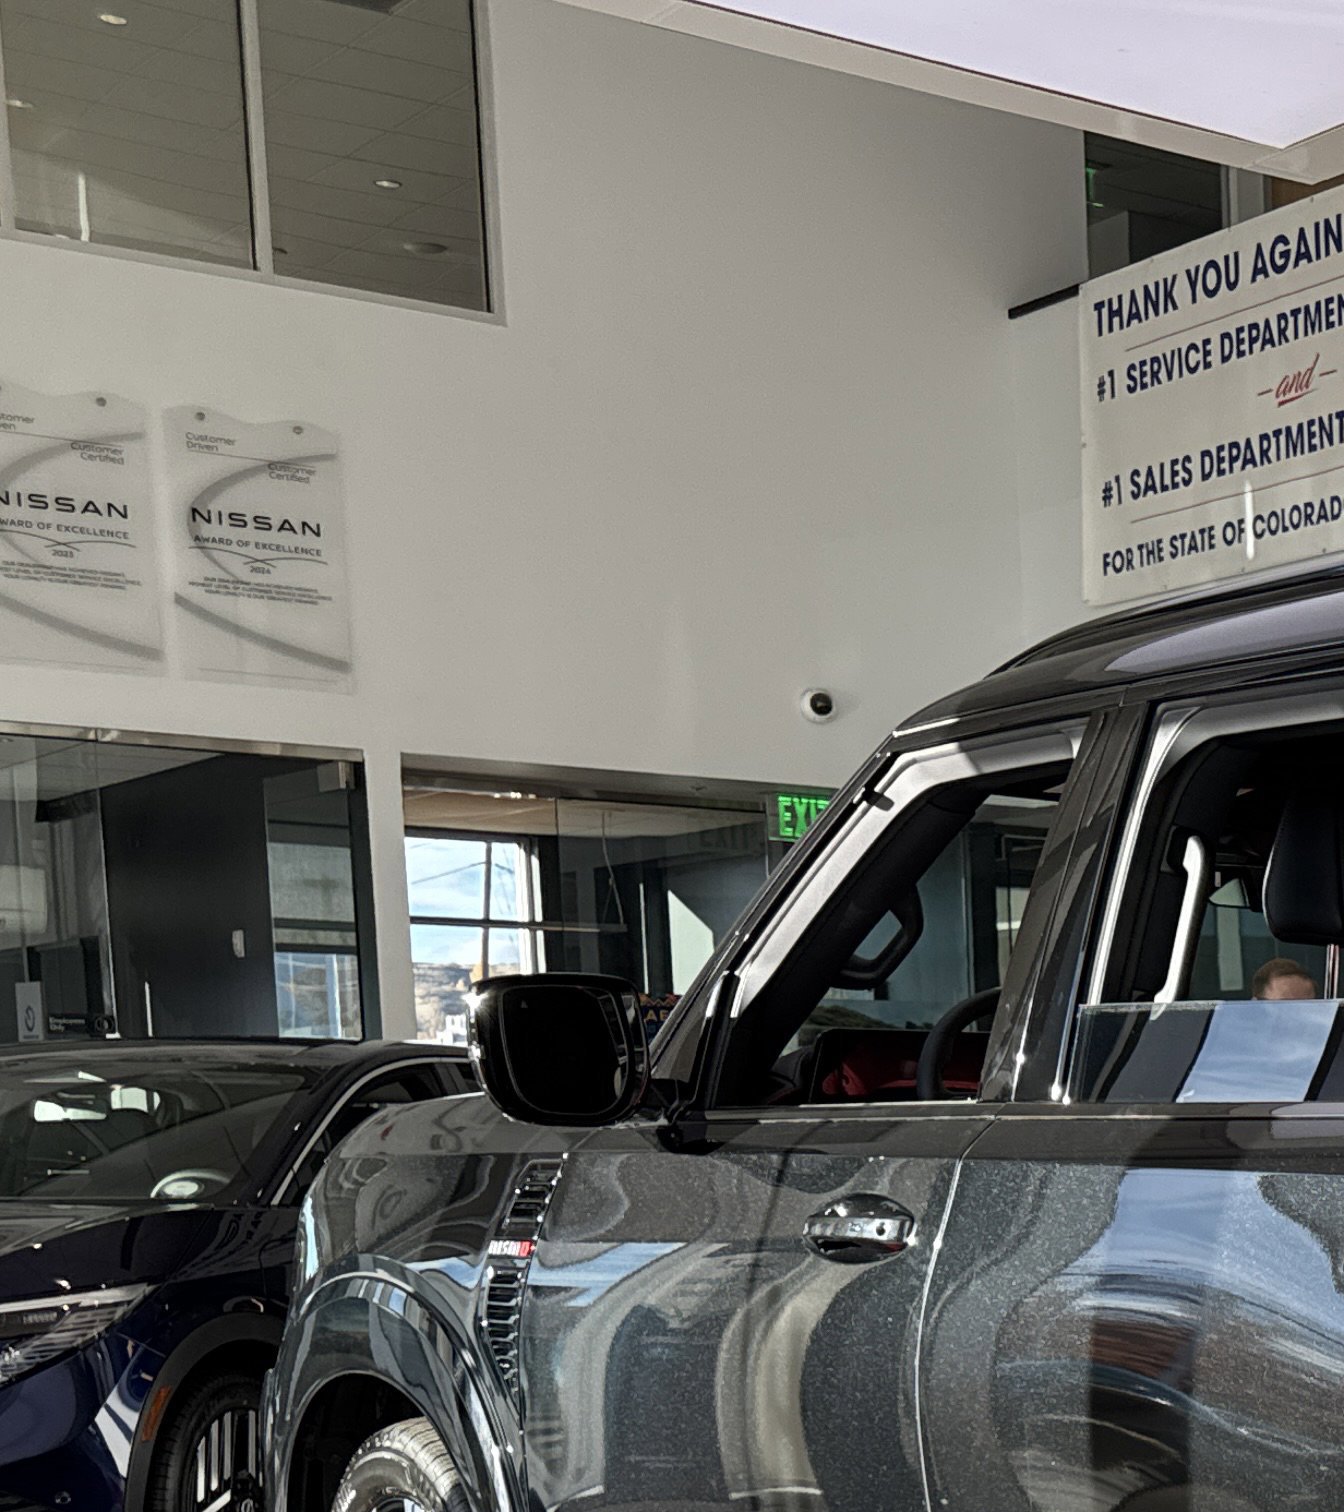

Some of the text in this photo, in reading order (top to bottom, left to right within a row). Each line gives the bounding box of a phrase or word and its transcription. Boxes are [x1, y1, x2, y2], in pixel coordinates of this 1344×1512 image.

[1093, 274, 1179, 337] THANK
[1185, 251, 1240, 304] YOU
[1250, 213, 1343, 284] AGAIN
[1097, 369, 1116, 402] #1
[1126, 337, 1213, 395] SERVICE
[1275, 353, 1320, 401] and
[185, 432, 236, 446] Customer
[1102, 474, 1123, 508] #1
[1129, 454, 1193, 501] SALES
[0, 518, 129, 540] WARD OF EXCELLENCE
[191, 507, 322, 538] NISSAN
[193, 534, 323, 557] AWARD OF EXCELLENCE
[1102, 546, 1135, 577] FOR
[1136, 539, 1164, 568] THE
[1168, 525, 1216, 561] STATE
[1222, 517, 1246, 546] OF
